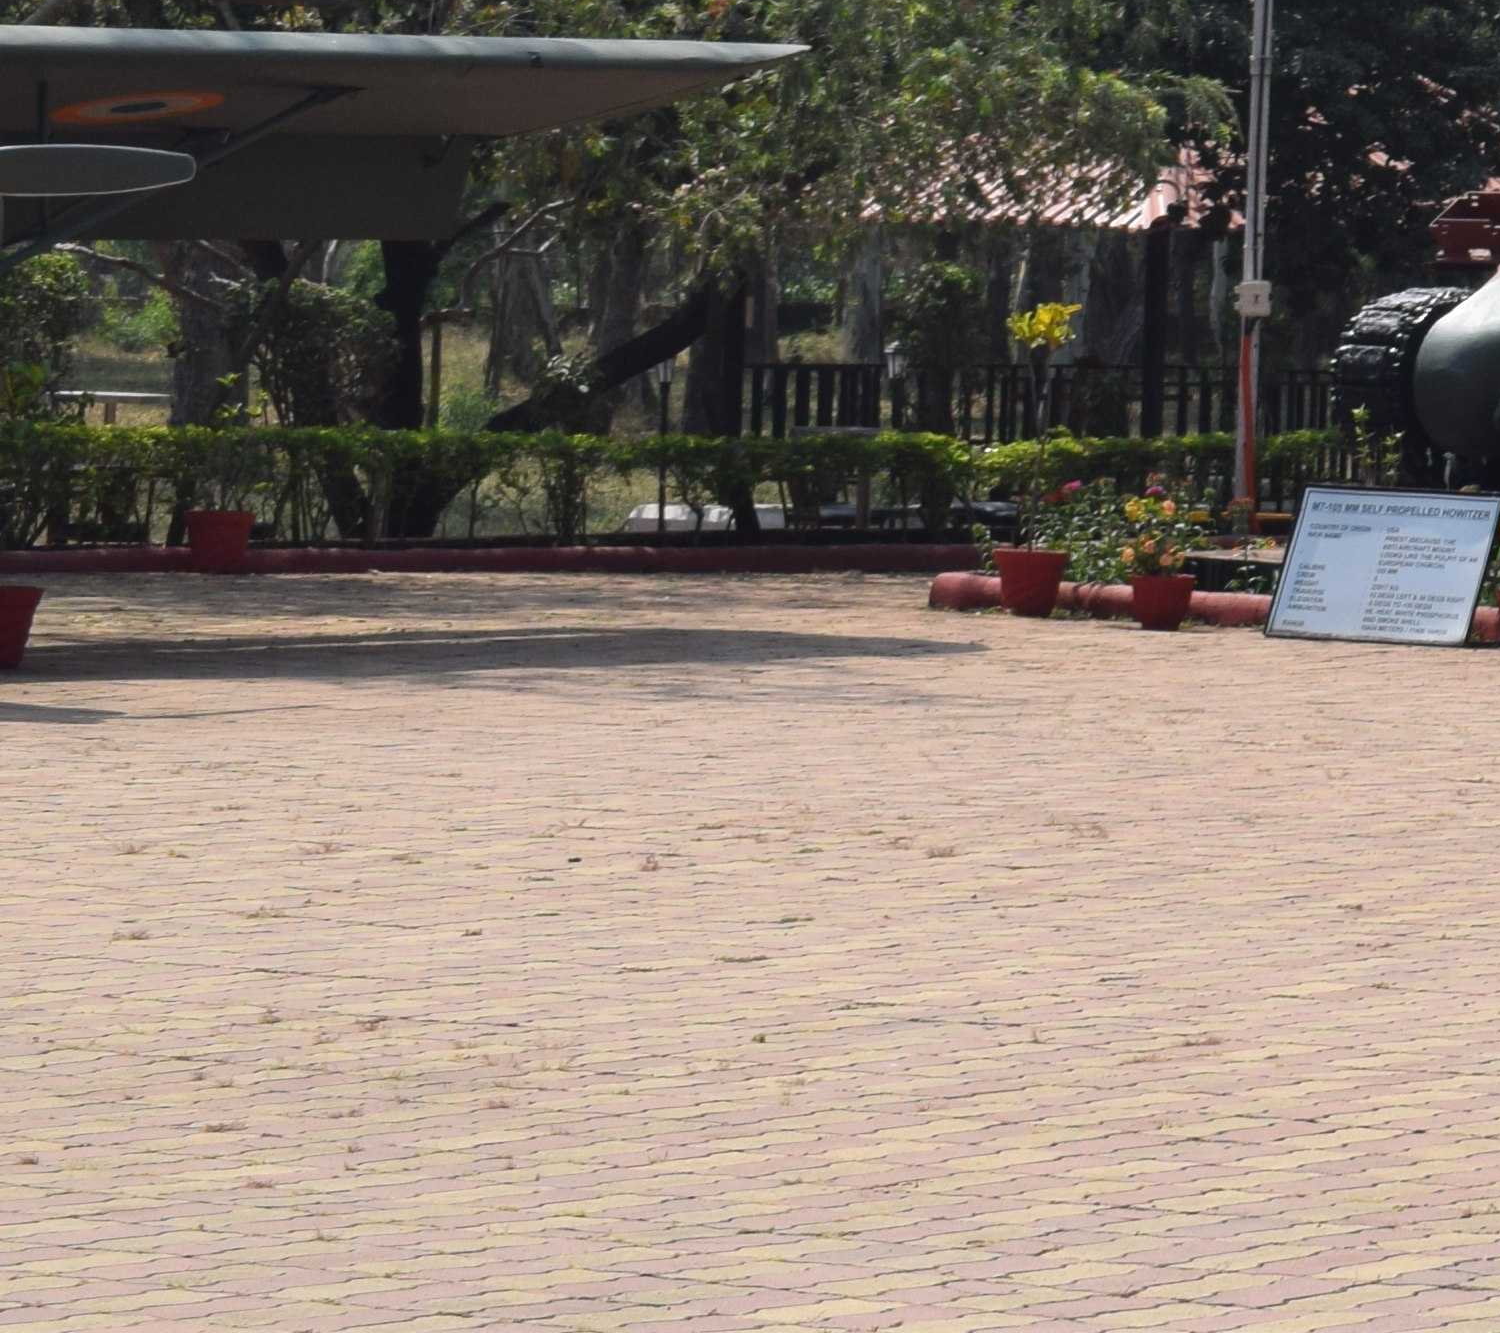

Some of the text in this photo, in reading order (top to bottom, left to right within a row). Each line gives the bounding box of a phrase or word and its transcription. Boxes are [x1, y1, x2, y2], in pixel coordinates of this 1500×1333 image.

[1361, 504, 1384, 515] SELF
[1386, 505, 1440, 518] PROPELLED
[1442, 509, 1491, 521] HOWITZER
